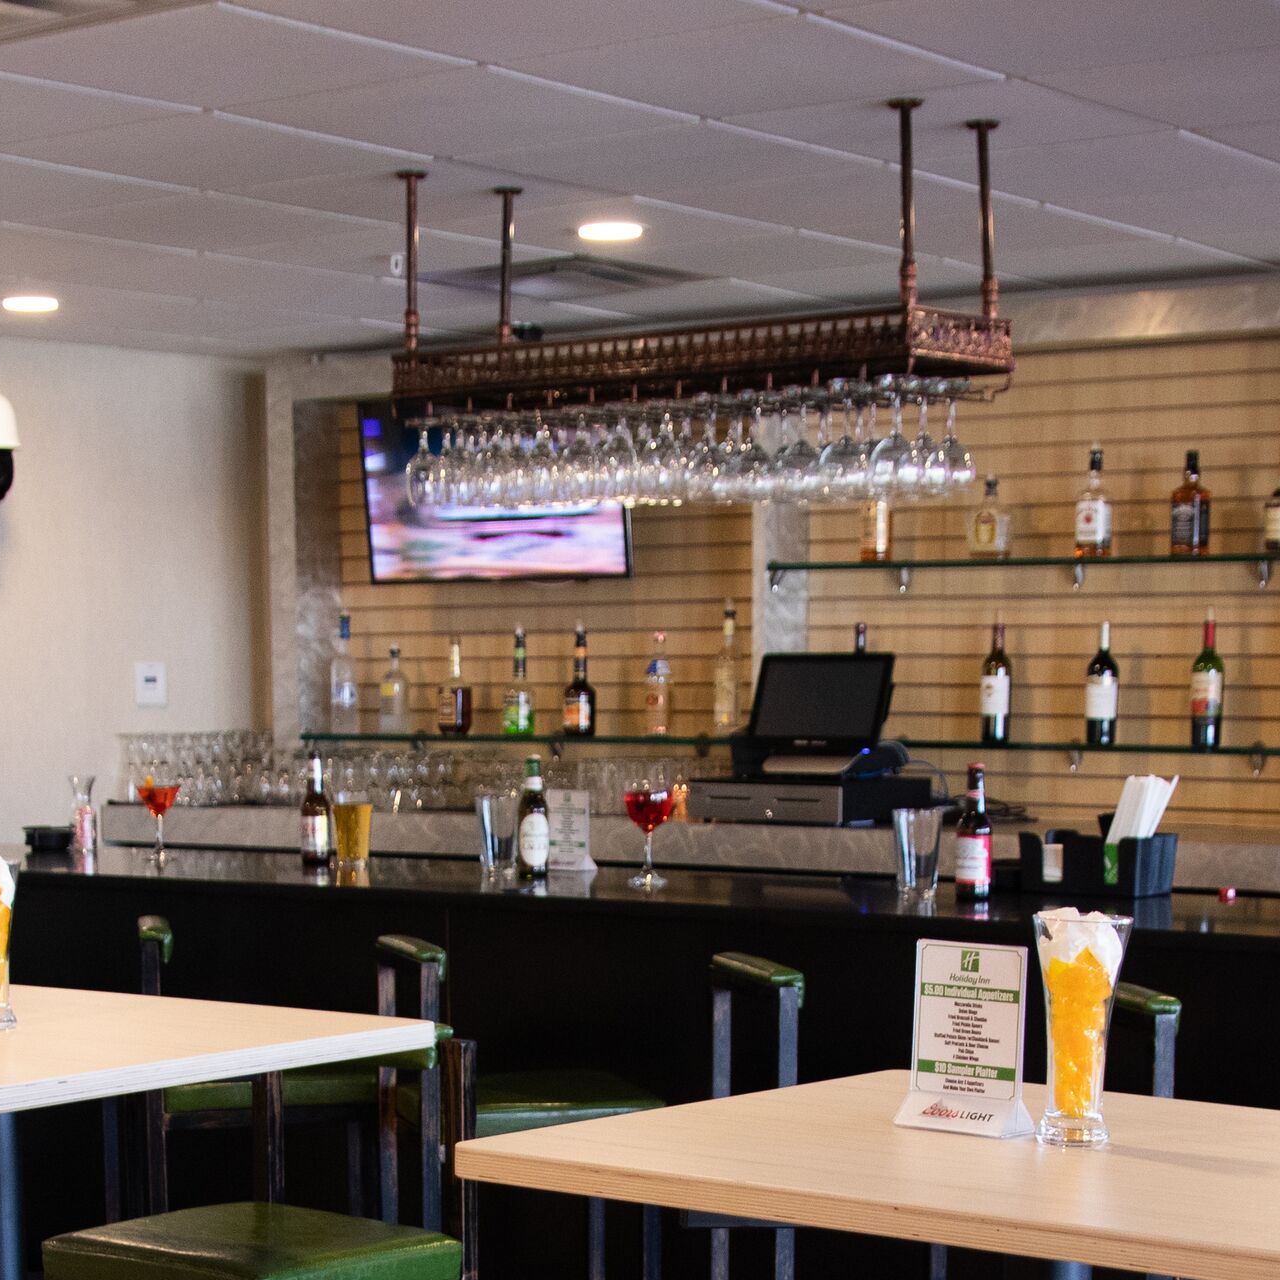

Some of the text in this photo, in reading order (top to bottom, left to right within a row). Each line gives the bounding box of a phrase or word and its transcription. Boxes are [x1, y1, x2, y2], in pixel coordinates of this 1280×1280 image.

[950, 974, 990, 985] Holiday Inn
[924, 984, 1014, 1002] $5.00 Individual Appetizers
[934, 1061, 998, 1078] $10 Sampler Platter
[922, 1103, 995, 1122] Coors LIGHT
